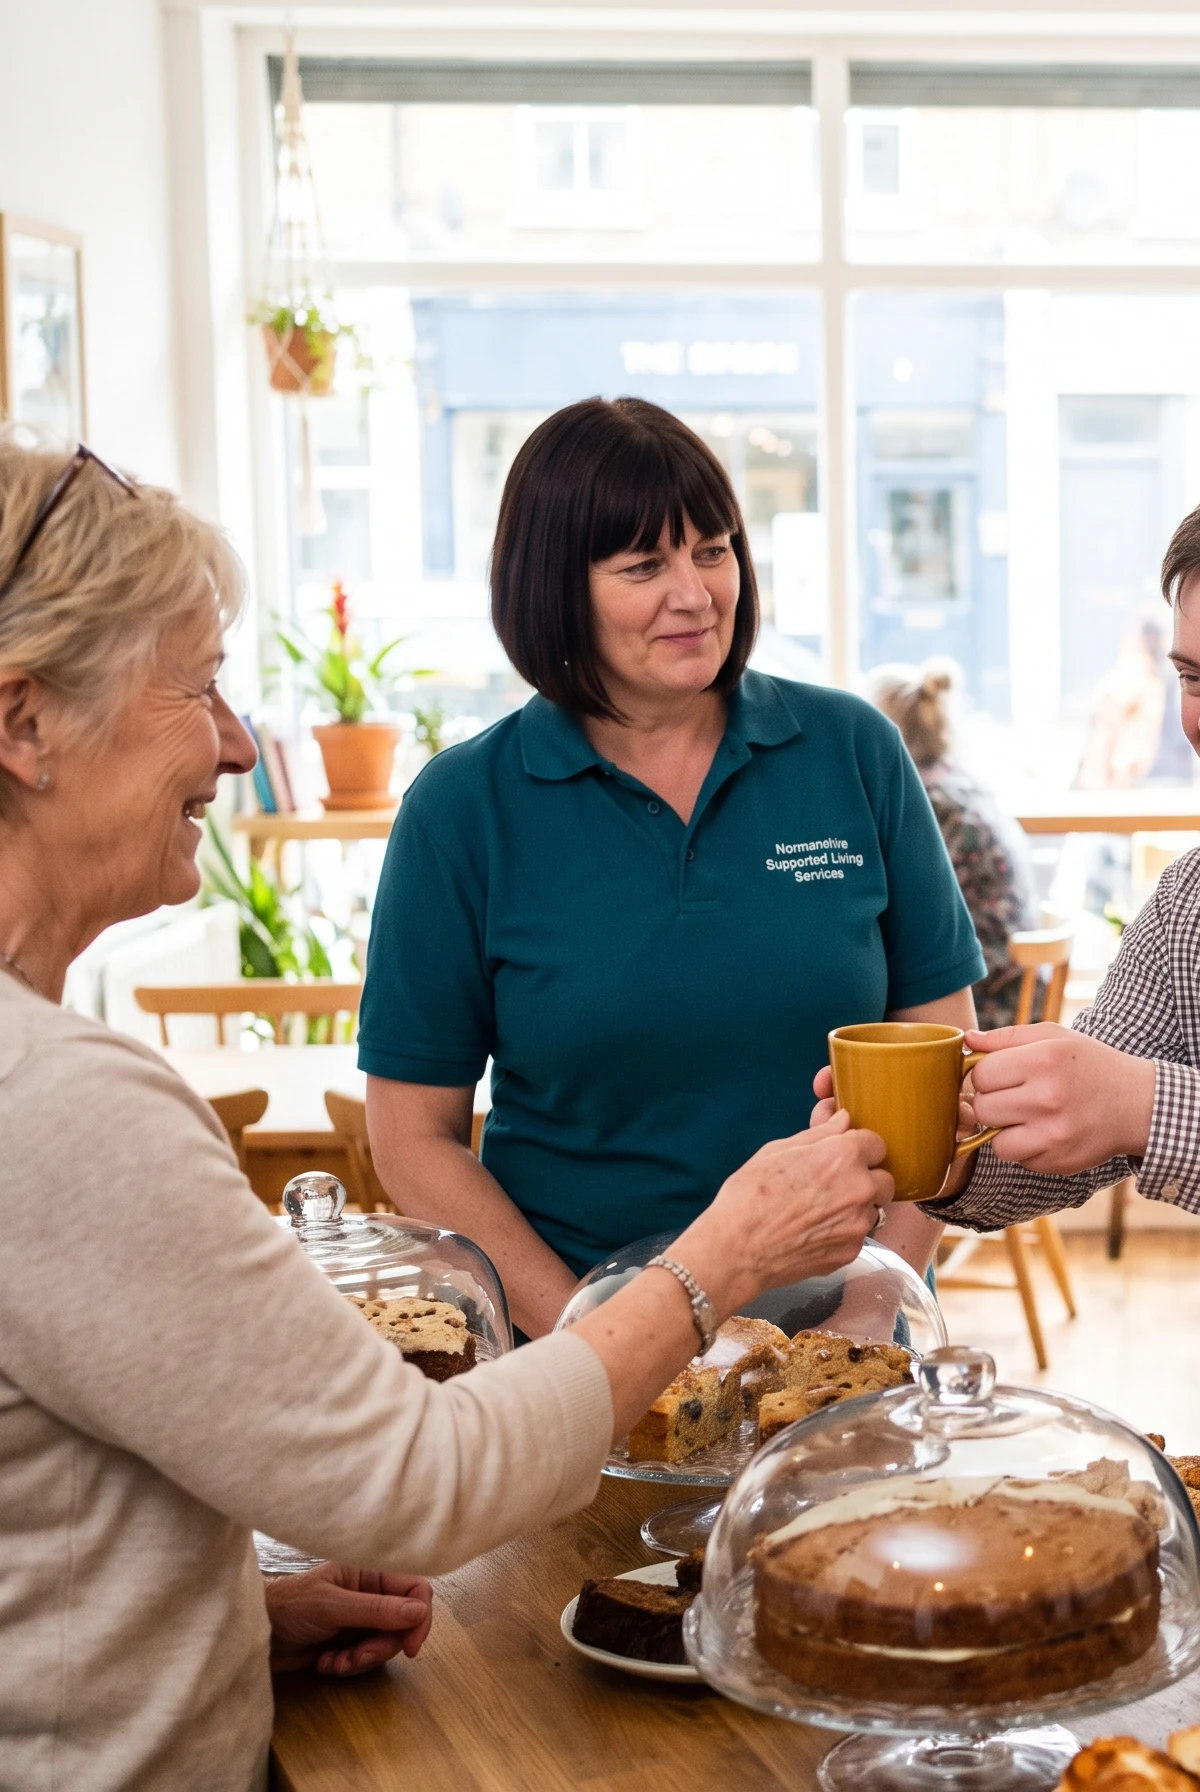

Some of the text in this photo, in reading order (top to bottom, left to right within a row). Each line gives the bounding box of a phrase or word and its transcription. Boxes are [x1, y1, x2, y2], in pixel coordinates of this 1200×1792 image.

[765, 852, 864, 872] Supported Living
[794, 868, 845, 883] Services
